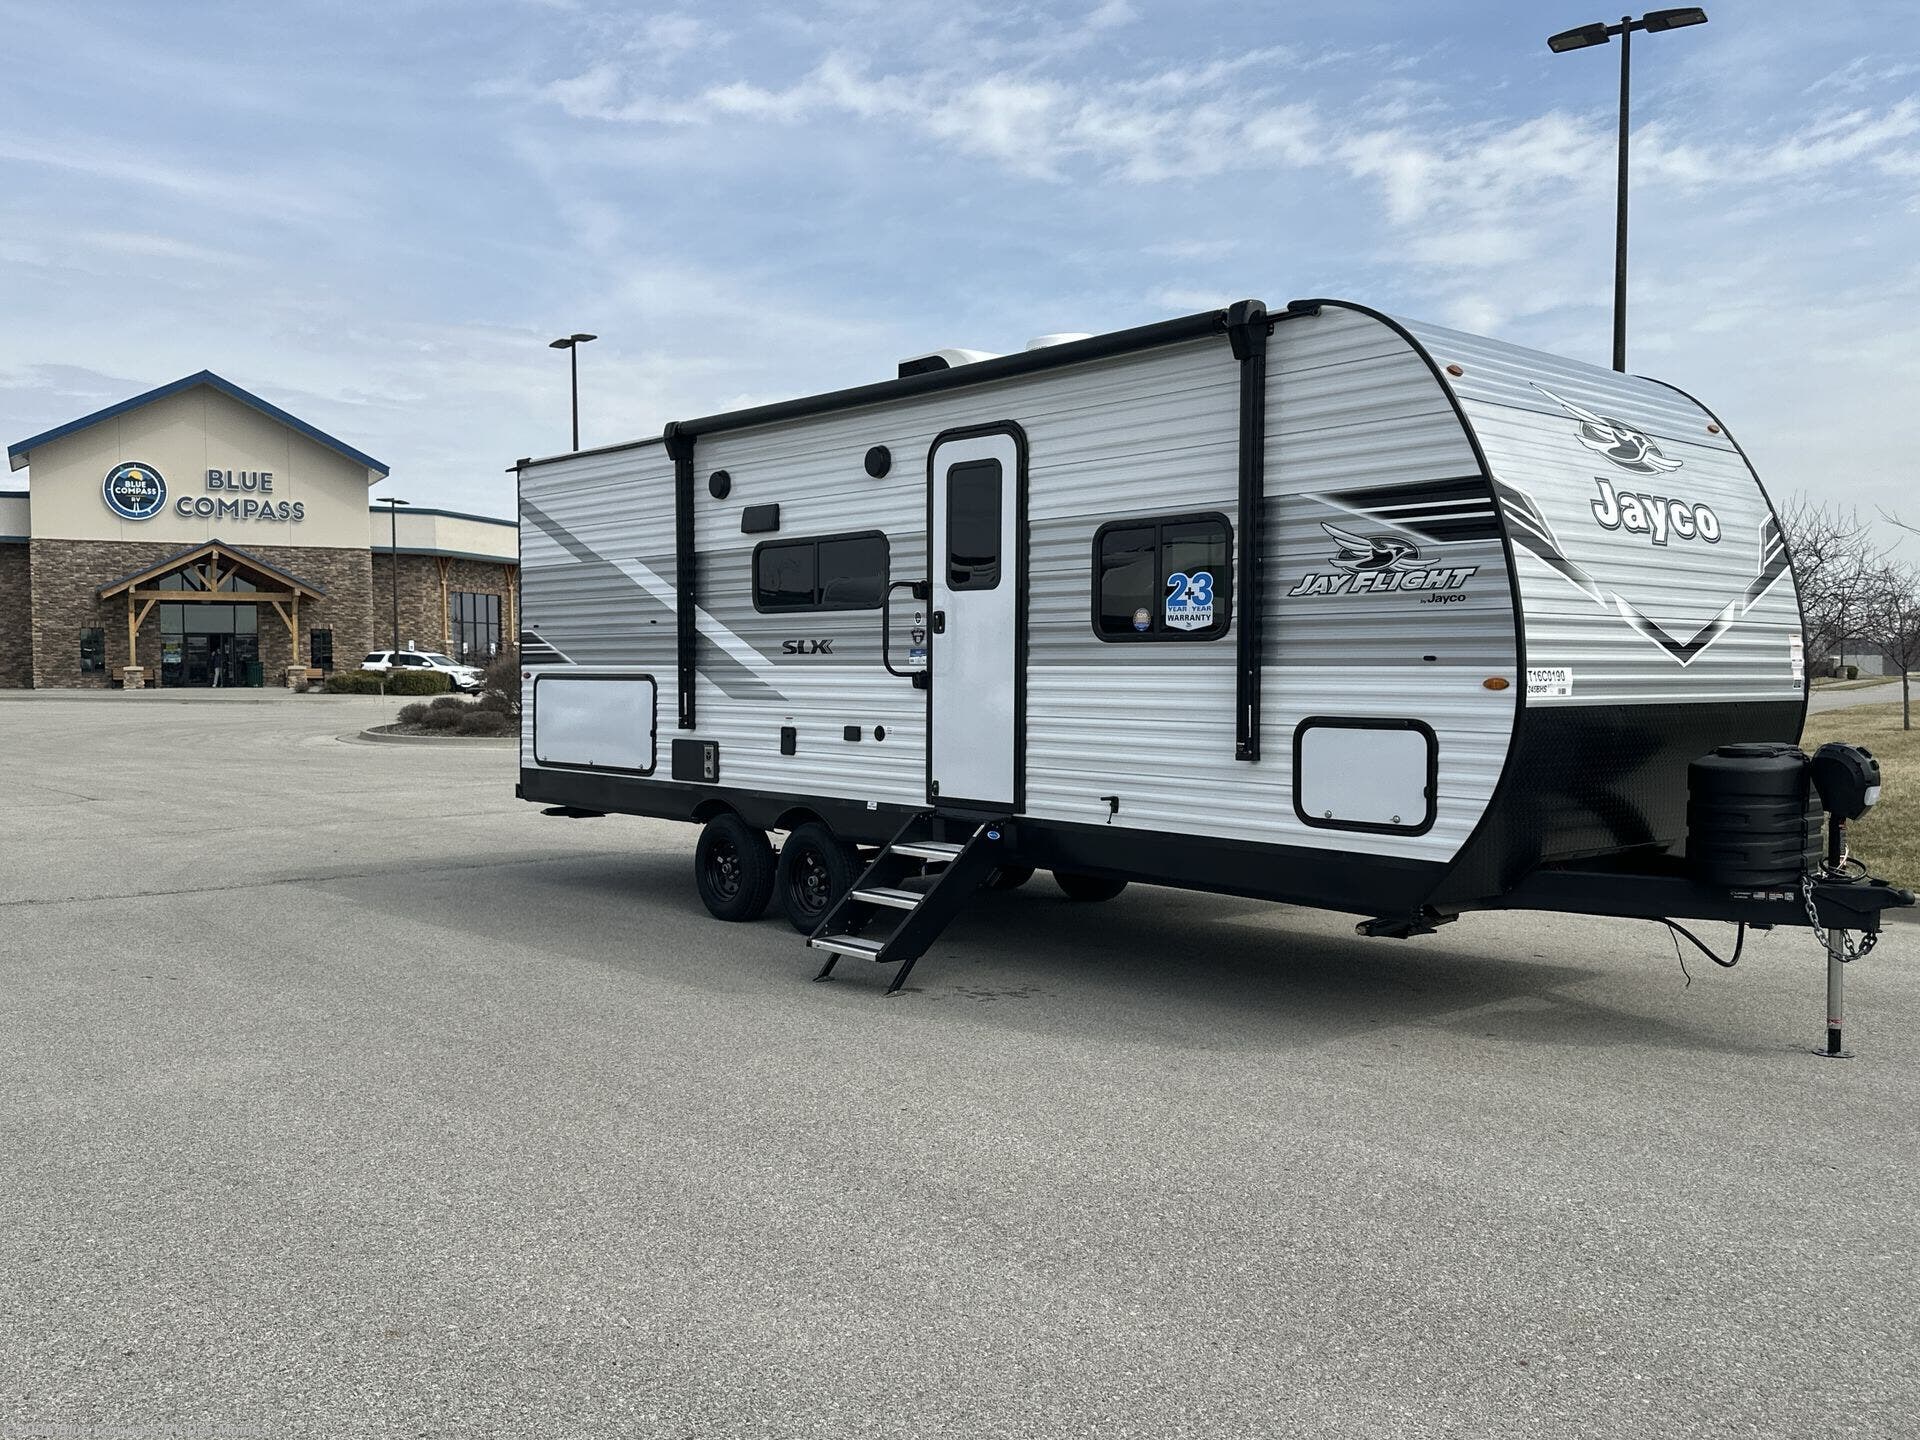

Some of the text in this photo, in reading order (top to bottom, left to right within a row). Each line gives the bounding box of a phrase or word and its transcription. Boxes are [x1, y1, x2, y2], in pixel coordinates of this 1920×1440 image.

[124, 480, 147, 488] BLUE
[207, 469, 273, 493] BLUE
[115, 487, 156, 495] COMPASS
[176, 496, 305, 522] COMPASS
[1590, 476, 1721, 546] Jayco
[1427, 593, 1466, 604] Jayco
[1167, 614, 1211, 622] WARRANTY
[783, 640, 833, 654] SLX
